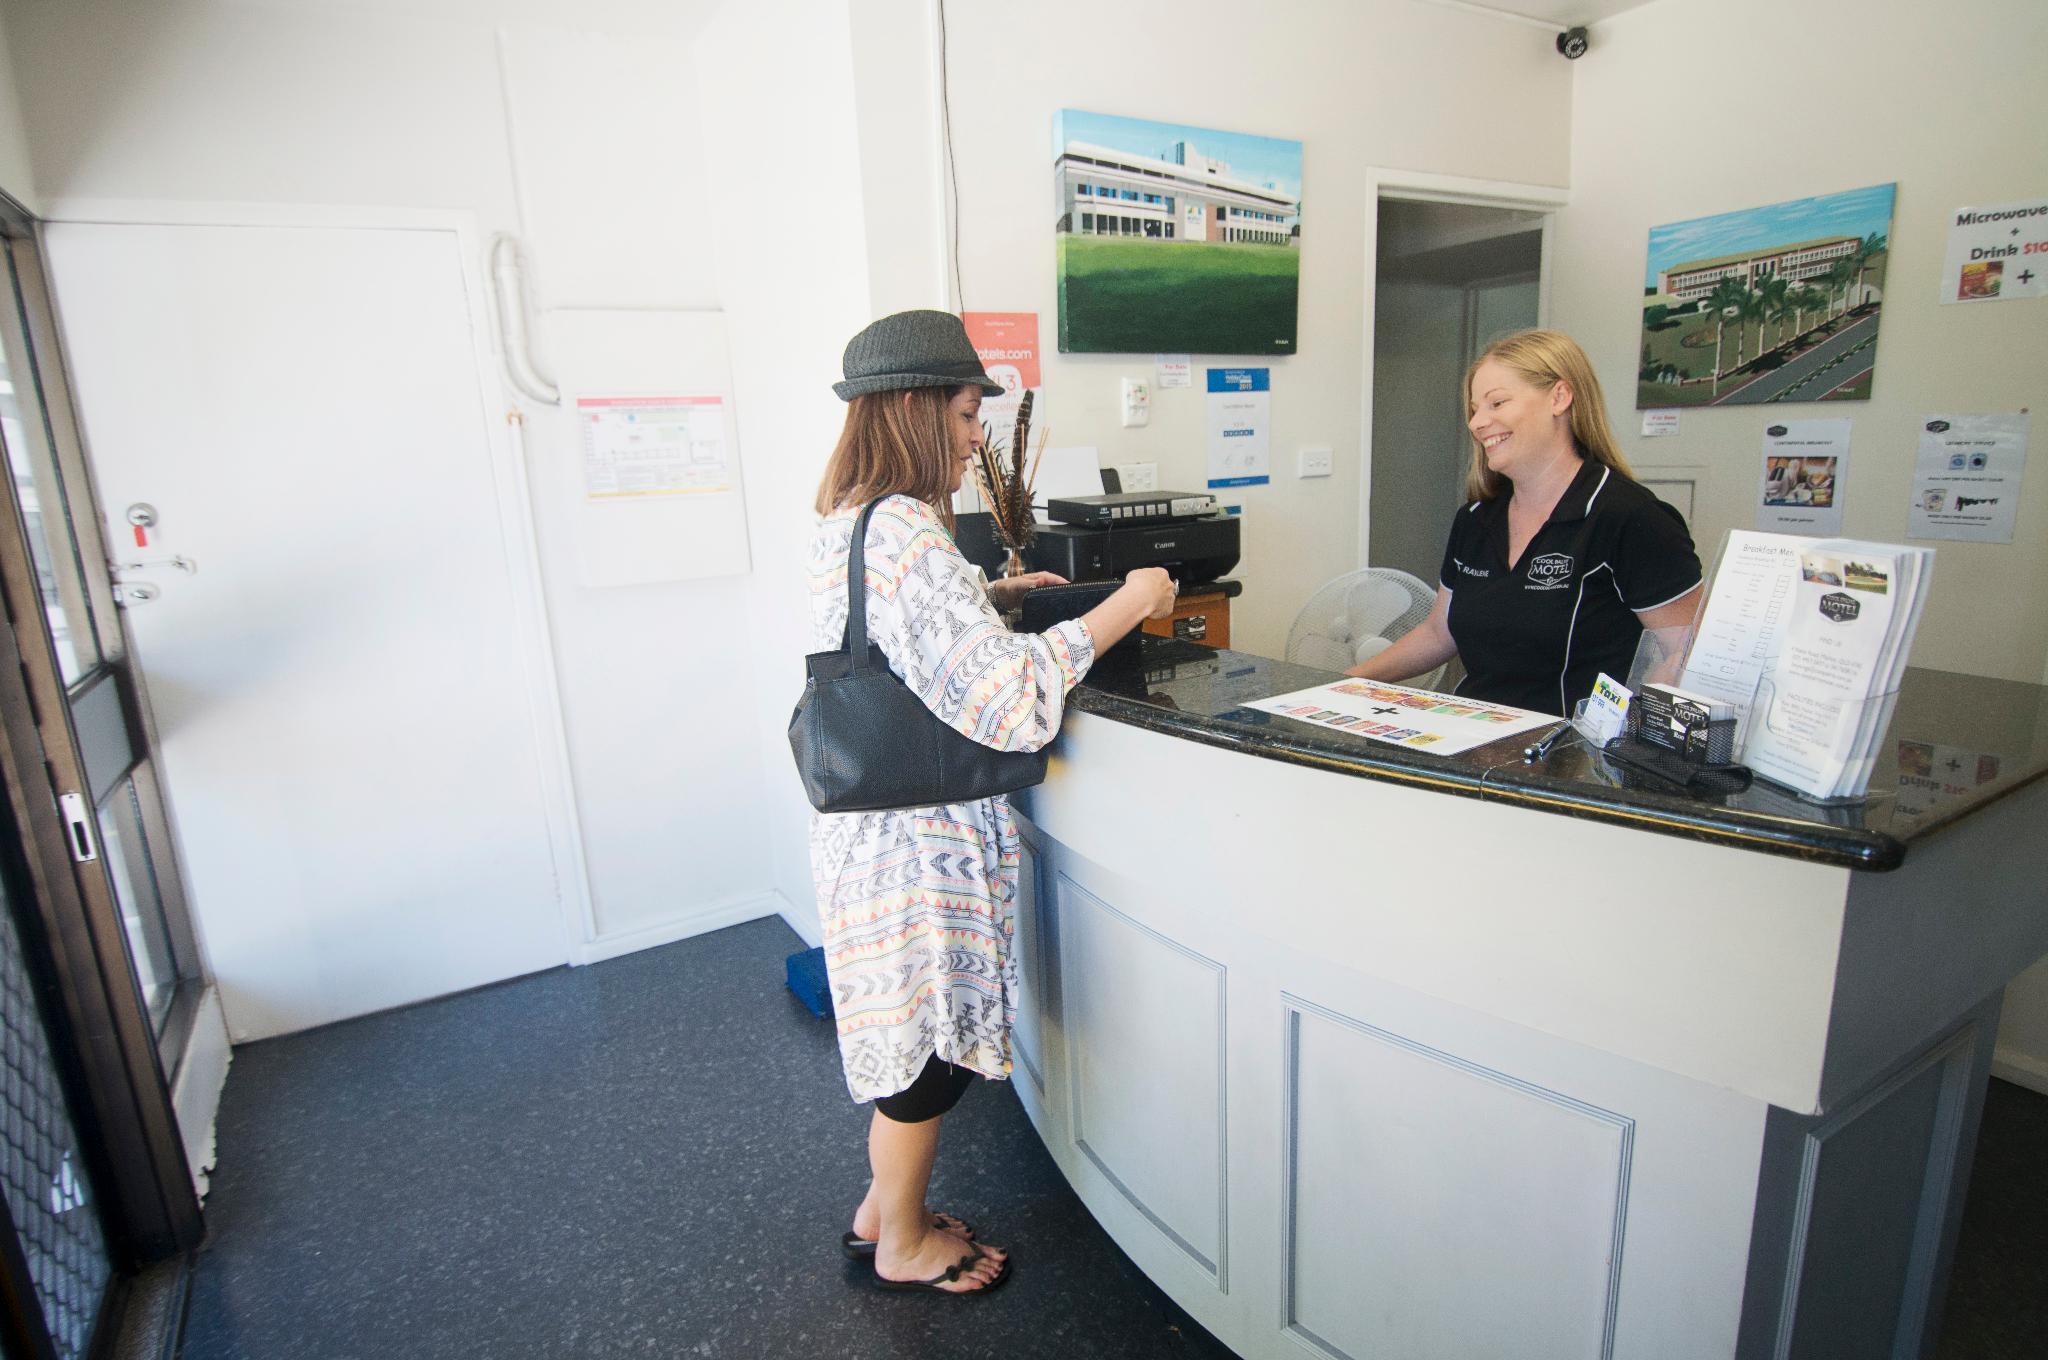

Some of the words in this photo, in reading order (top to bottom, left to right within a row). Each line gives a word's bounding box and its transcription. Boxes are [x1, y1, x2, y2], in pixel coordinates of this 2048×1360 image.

[1956, 204, 2048, 226] Microwave
[1969, 244, 2019, 260] Drink
[974, 347, 1032, 361] otels.com
[1155, 541, 1175, 549] Canon
[1742, 543, 1777, 555] Breakfast
[1779, 546, 1794, 557] Men
[1531, 563, 1570, 576] MOTEL
[1822, 600, 1857, 616] MOTEL
[1600, 685, 1622, 706] Taxi
